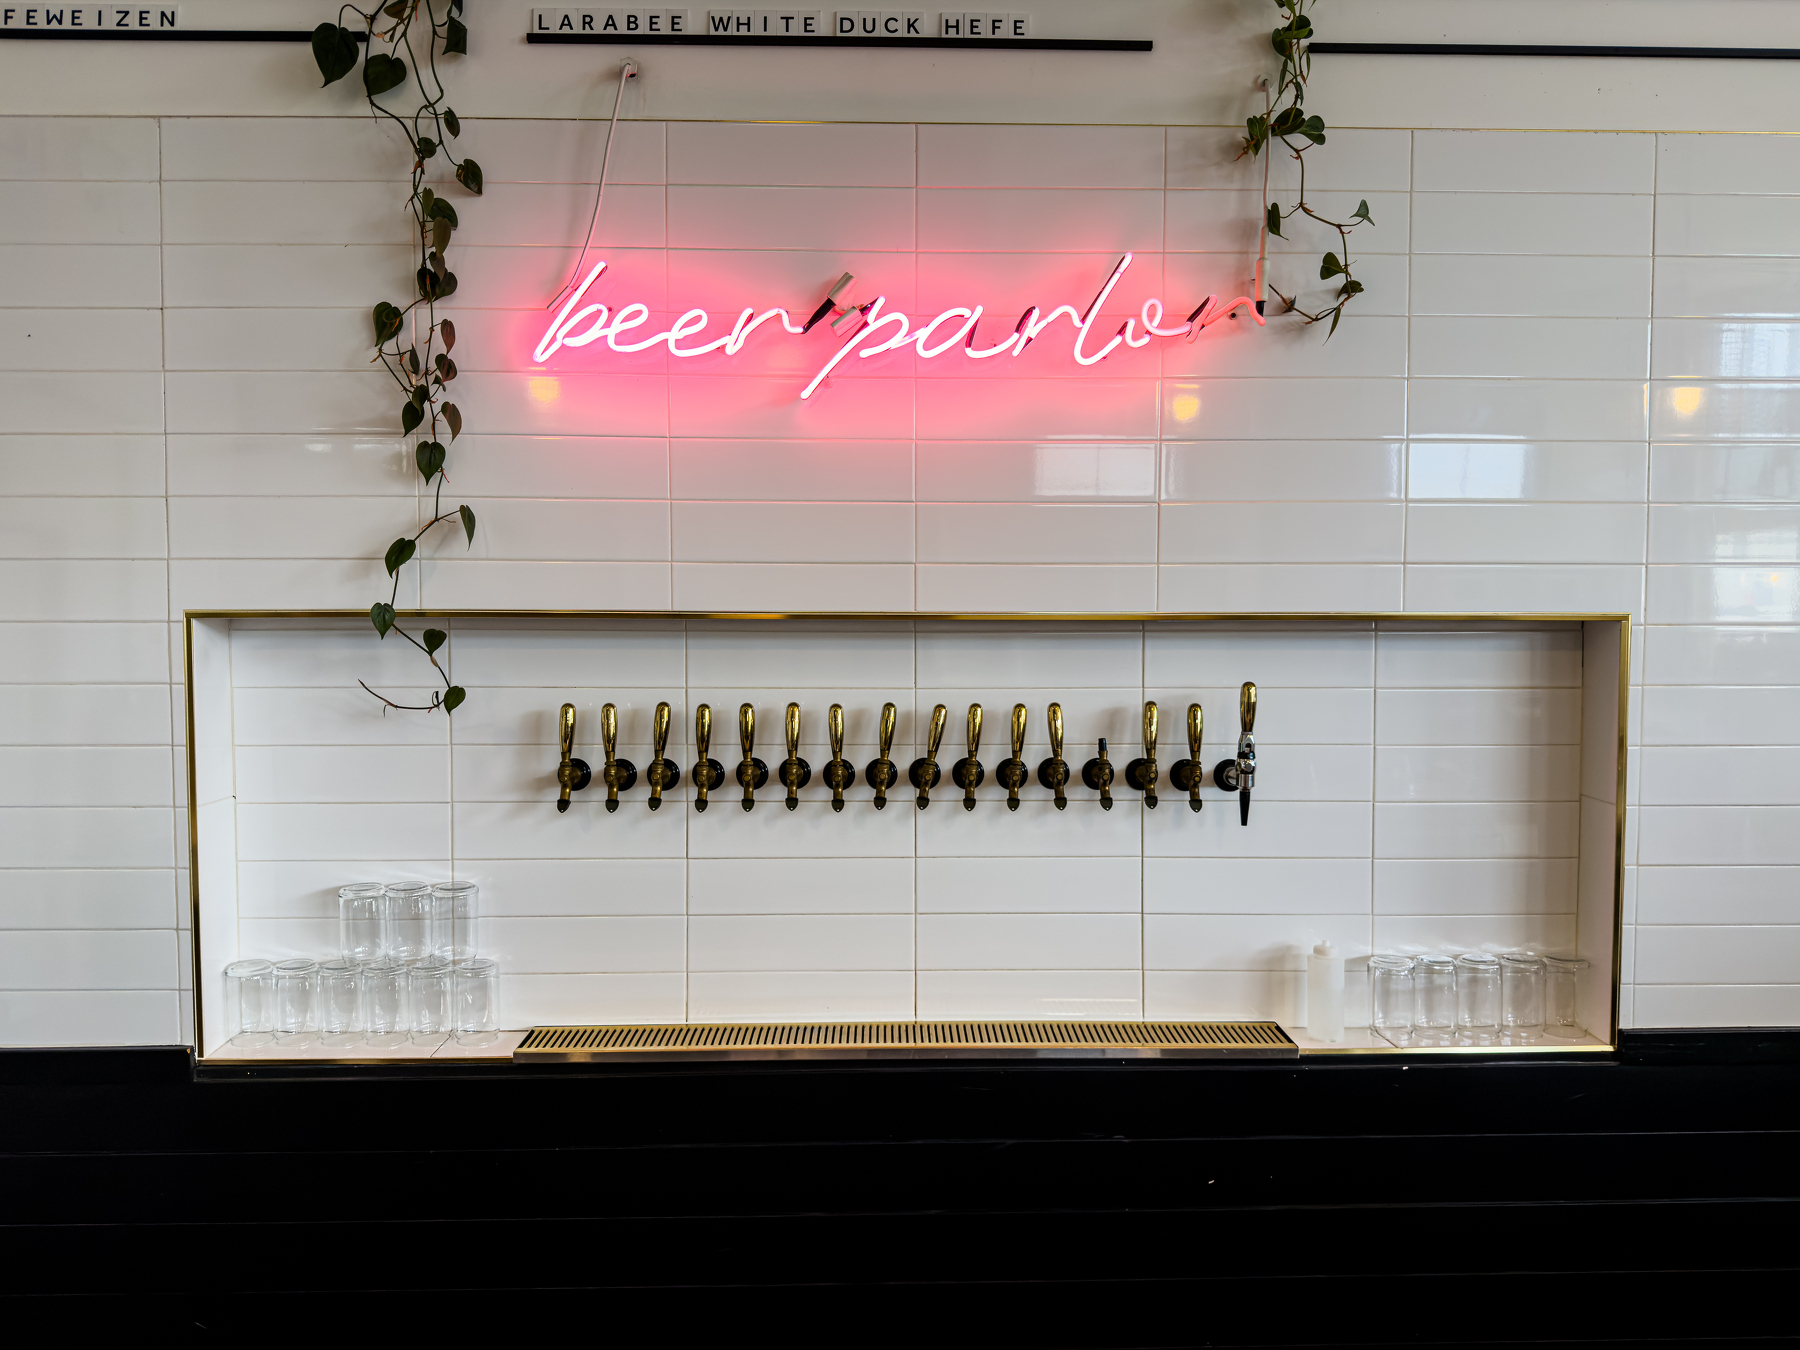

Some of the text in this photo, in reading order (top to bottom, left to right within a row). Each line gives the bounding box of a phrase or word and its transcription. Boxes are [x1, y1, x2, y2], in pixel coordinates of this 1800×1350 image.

[3, 9, 176, 27] FEWEIZEN
[537, 14, 1025, 36] LARABEE WHITE DUCK HEFE
[533, 252, 1266, 399] beer parlor
